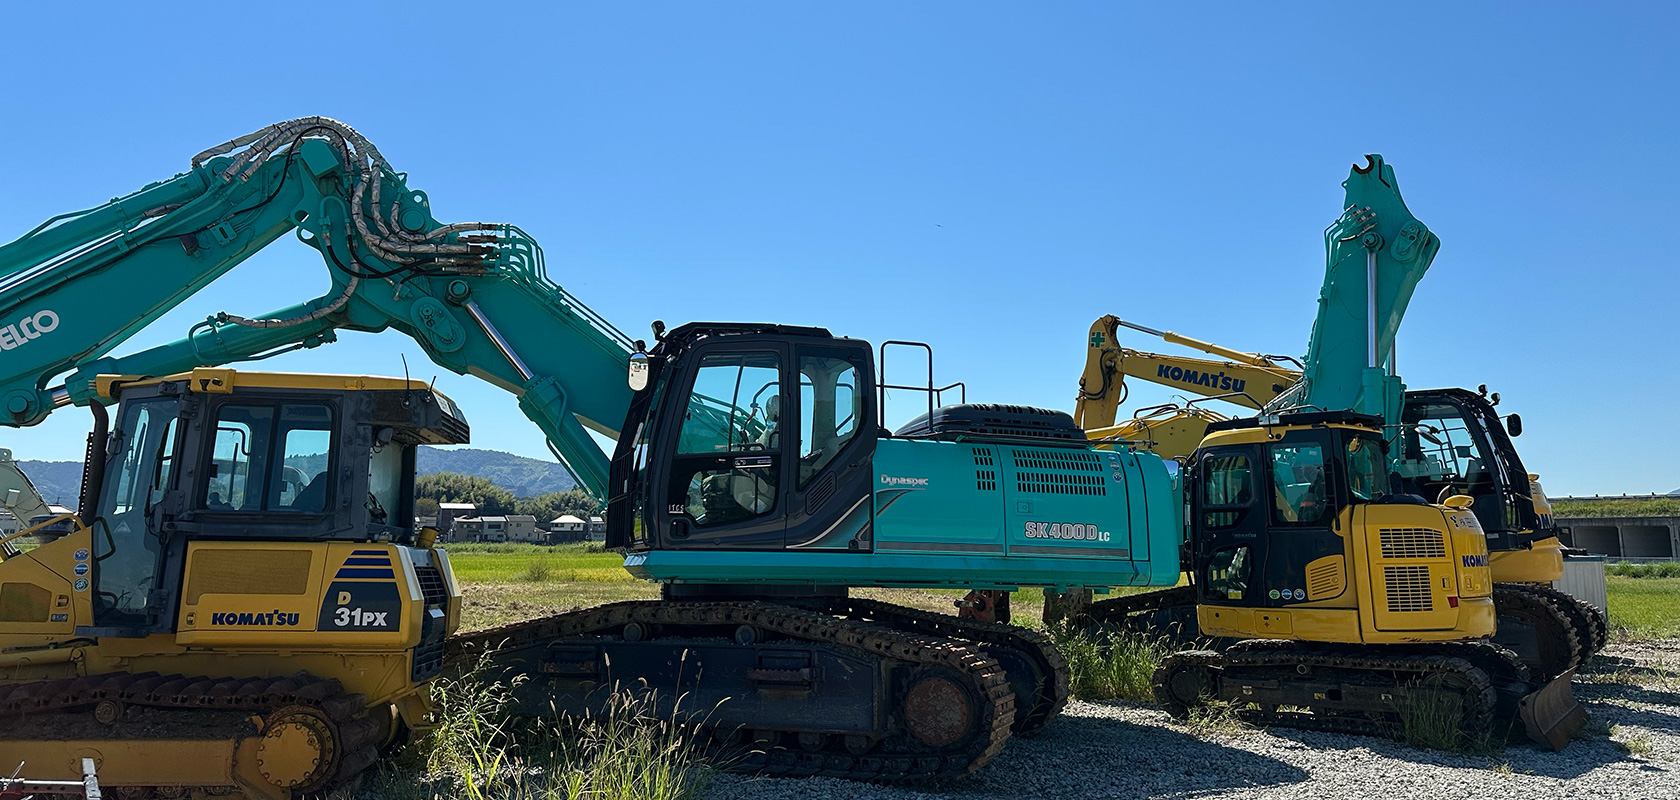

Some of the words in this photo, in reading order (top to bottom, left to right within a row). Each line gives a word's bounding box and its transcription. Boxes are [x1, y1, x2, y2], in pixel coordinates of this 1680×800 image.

[0, 309, 60, 352] ELCO
[1157, 364, 1246, 392] KOMATSU
[881, 474, 929, 487] Dynaspec
[337, 591, 352, 605] D
[211, 609, 300, 626] KOMATSU
[334, 607, 388, 627] 31PX
